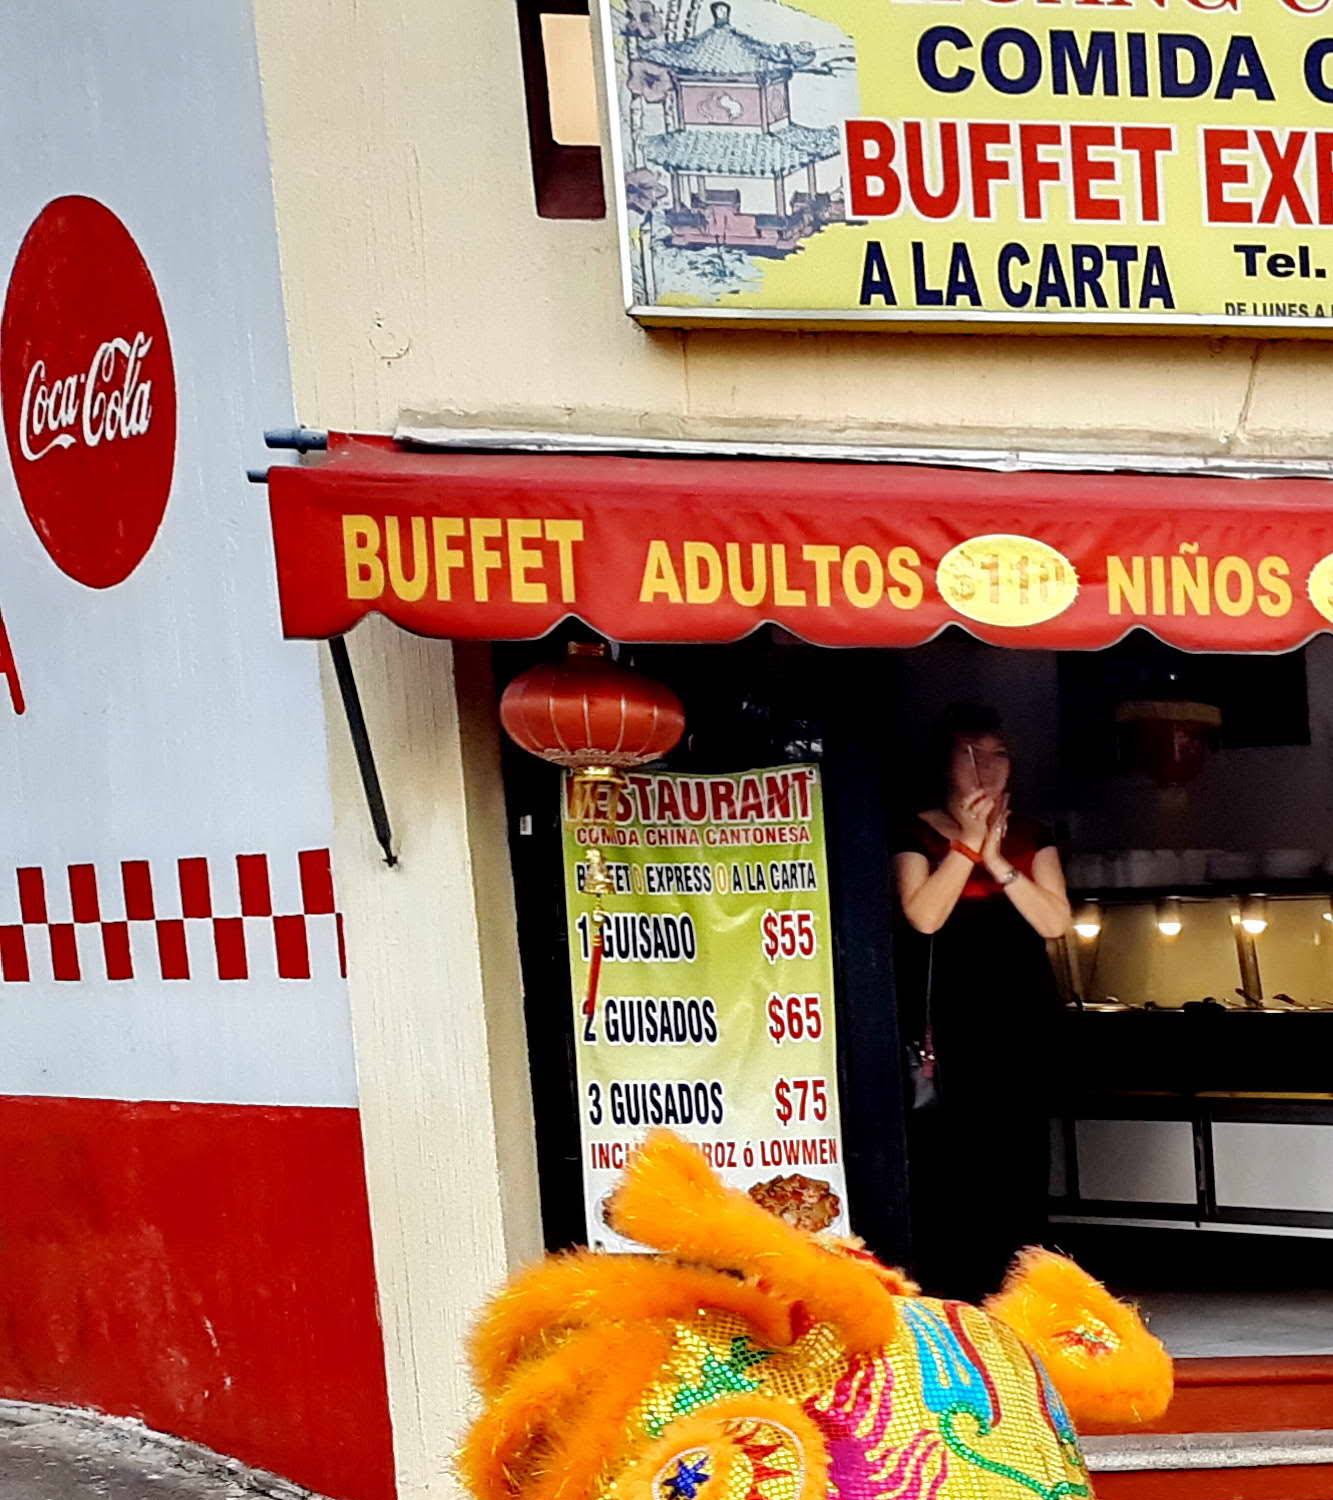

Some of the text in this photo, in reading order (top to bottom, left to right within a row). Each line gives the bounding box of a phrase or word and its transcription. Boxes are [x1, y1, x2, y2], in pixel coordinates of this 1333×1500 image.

[916, 25, 1276, 101] COMIDA
[844, 119, 1171, 222] BUFFET
[859, 240, 1175, 310] A LA CARTA
[1234, 244, 1326, 278] Tel.
[1253, 303, 1308, 318] LUNES
[1314, 304, 1325, 318] A
[19, 331, 152, 462] Coca-Cola
[342, 515, 584, 604] BUFFET
[640, 539, 924, 611] ADULTOS
[1107, 541, 1292, 617] NIÑOS
[646, 827, 699, 846] CHINA
[705, 827, 810, 845] CANTONESA
[646, 864, 711, 893] EXPRESS
[733, 865, 743, 891] A
[748, 864, 765, 891] LA
[770, 862, 817, 890] CARTA
[578, 912, 814, 960] 1 GUISADO $55
[605, 999, 718, 1043] GUISADOS
[768, 995, 822, 1043] $65
[588, 1078, 827, 1126] 3 GUISADOS $75
[760, 1138, 838, 1167] LOWMEN
